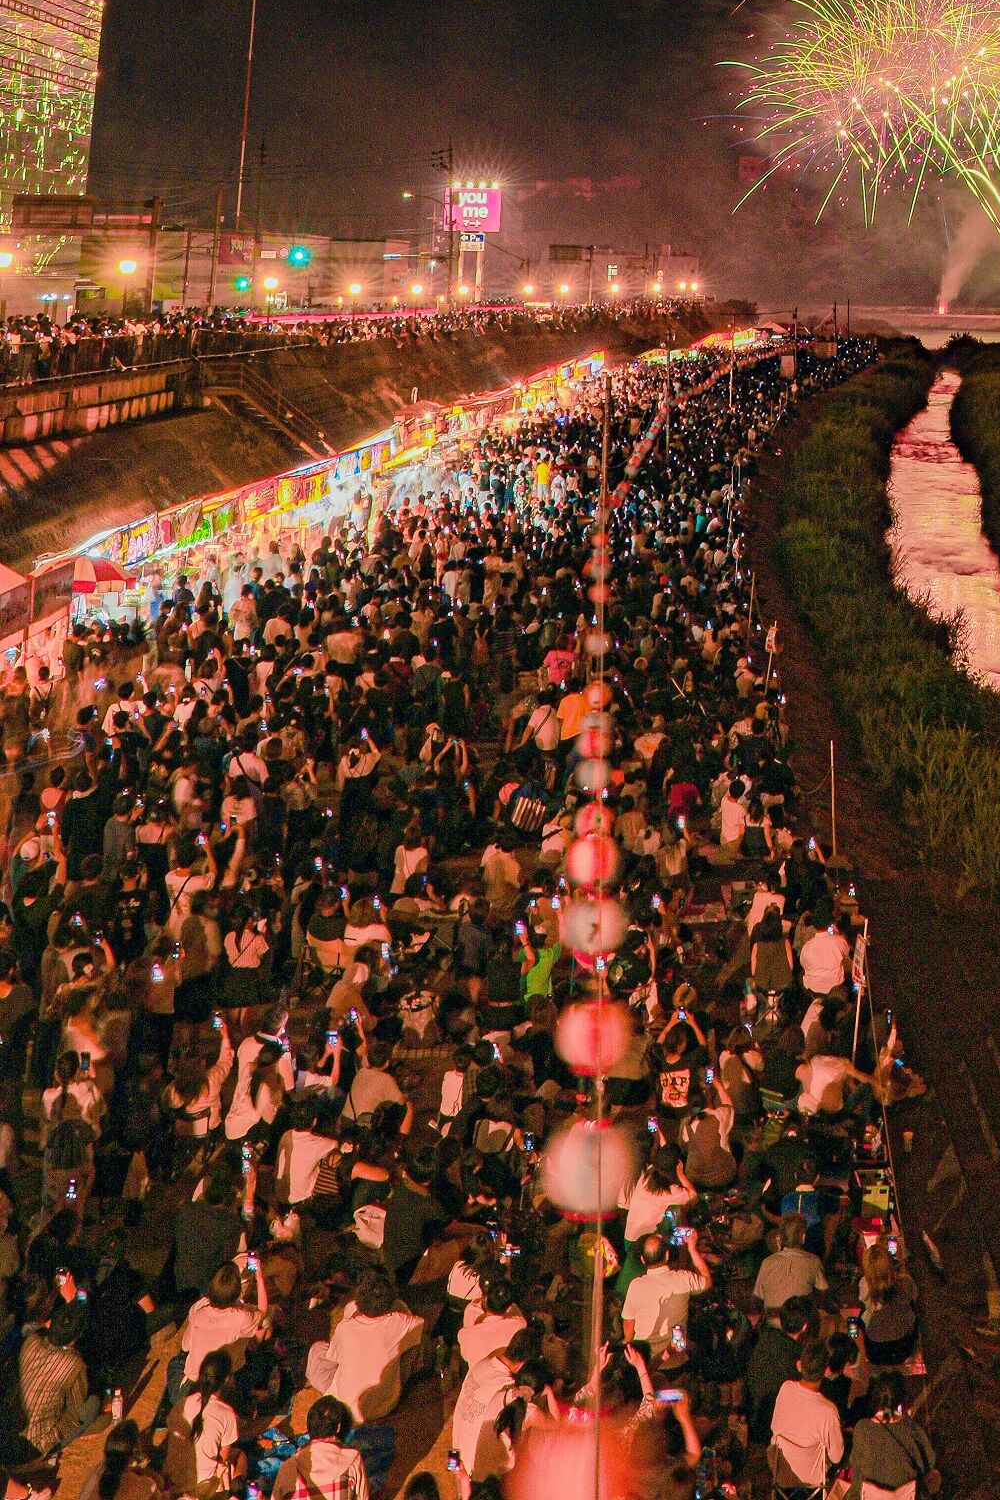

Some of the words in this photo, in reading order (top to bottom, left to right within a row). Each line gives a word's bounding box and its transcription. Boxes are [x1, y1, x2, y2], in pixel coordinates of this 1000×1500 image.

[458, 192, 487, 208] you
[463, 206, 488, 218] me
[462, 219, 482, 228] マート
